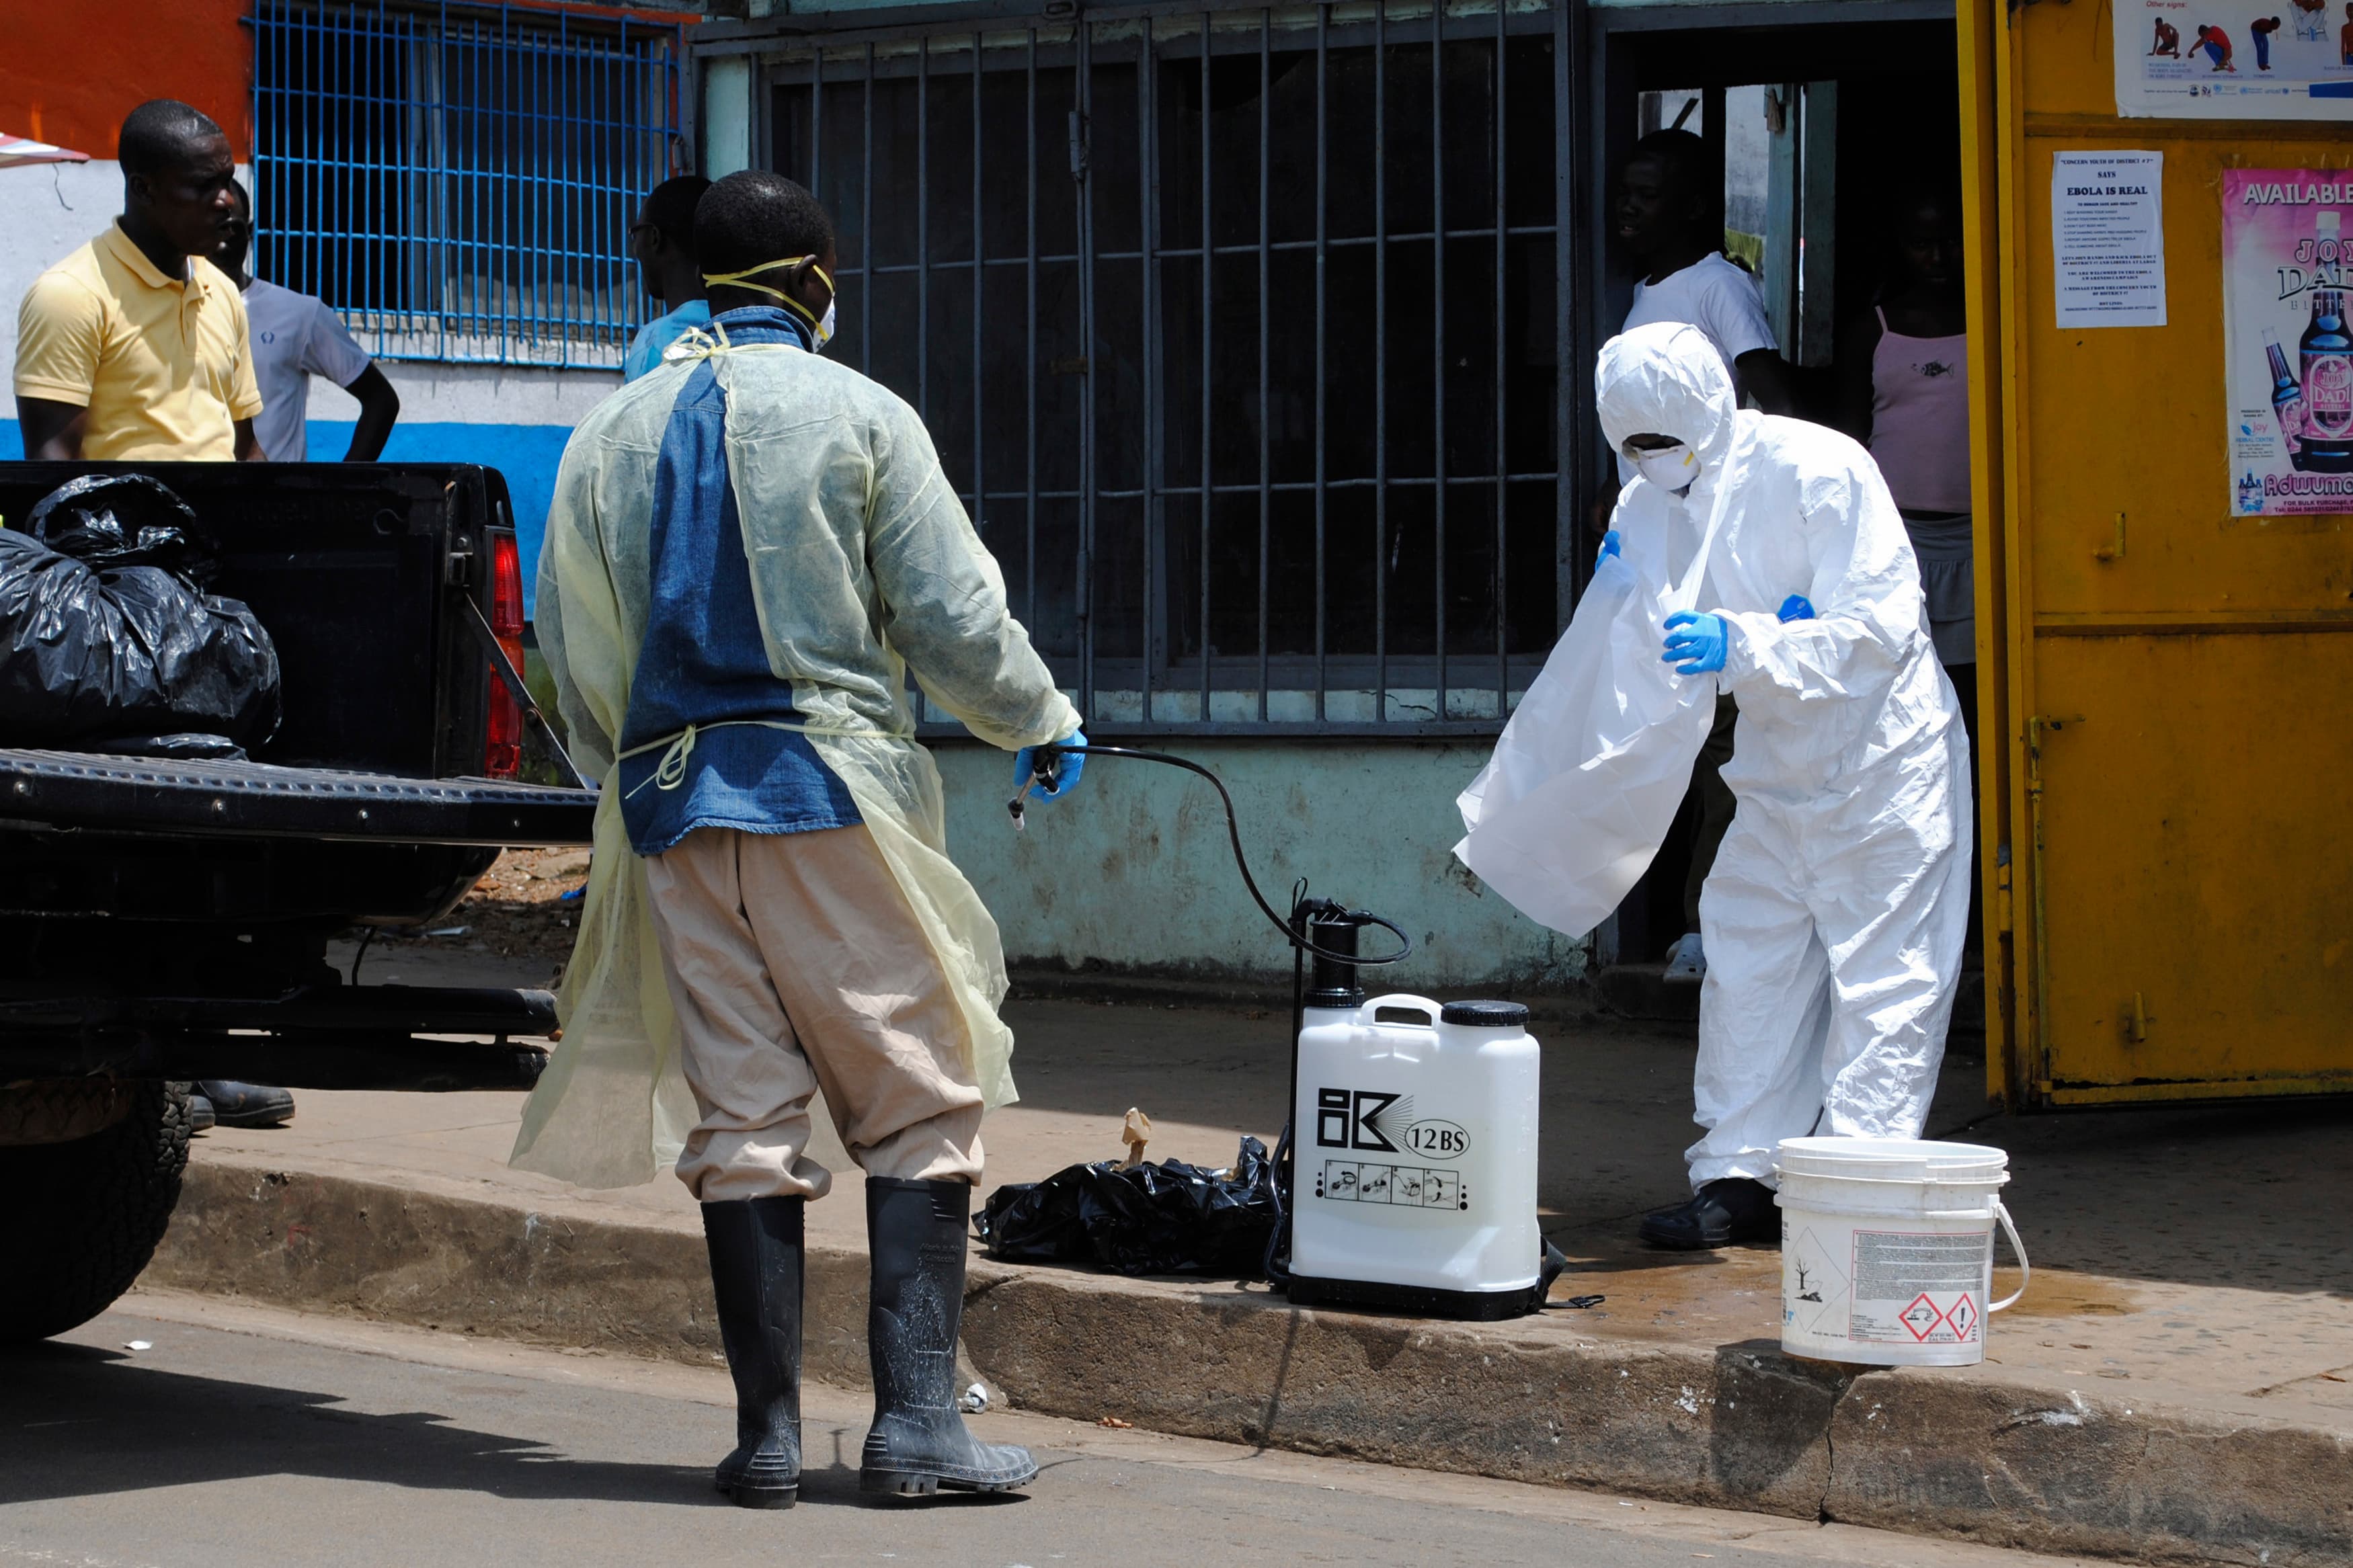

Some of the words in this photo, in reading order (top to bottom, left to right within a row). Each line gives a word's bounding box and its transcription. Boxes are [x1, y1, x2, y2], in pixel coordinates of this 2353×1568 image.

[2067, 187, 2103, 196] EBOLA
[2106, 187, 2116, 195] IS
[2119, 185, 2148, 195] REAL
[2244, 183, 2353, 205] AVAILABLE
[2290, 298, 2353, 310] BITTE
[1411, 1128, 1464, 1152] 12BS
